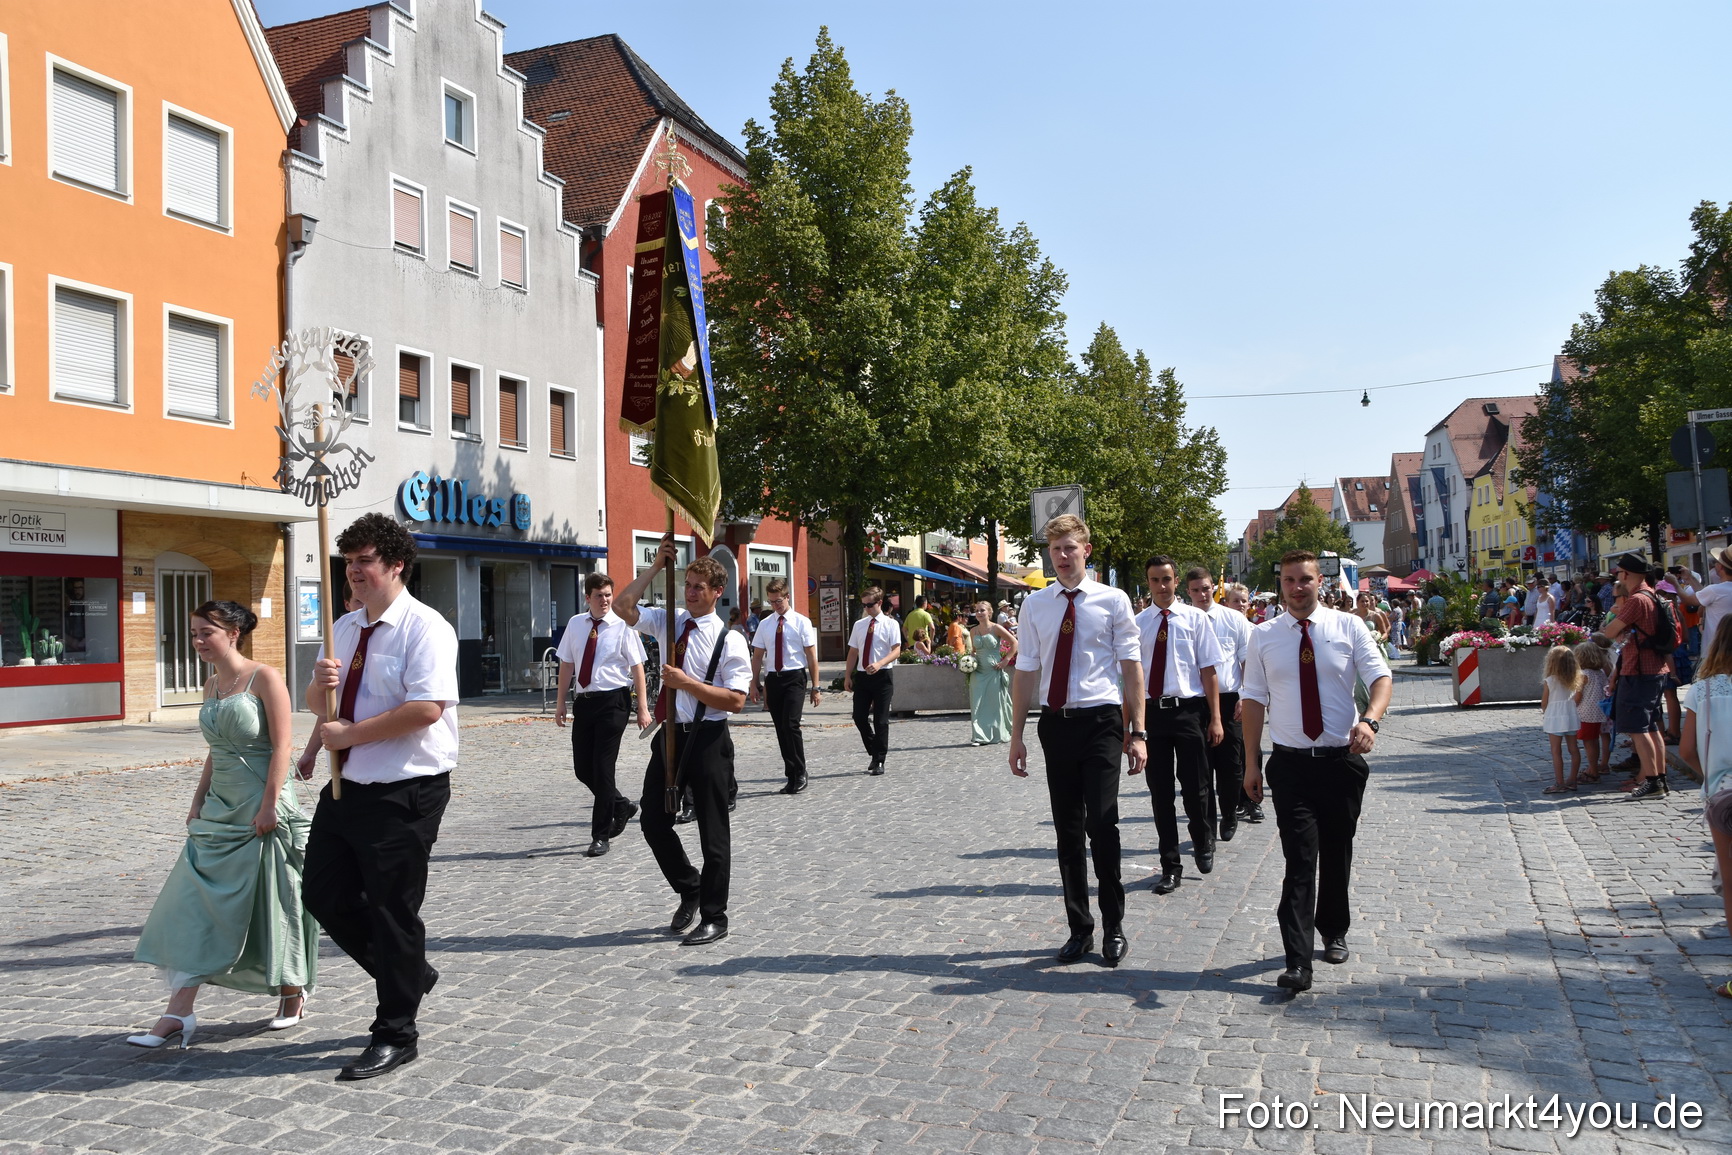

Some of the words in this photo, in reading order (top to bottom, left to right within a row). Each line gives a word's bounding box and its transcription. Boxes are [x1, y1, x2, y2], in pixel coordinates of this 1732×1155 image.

[250, 326, 377, 402] Burschenverein
[1696, 412, 1714, 420] Ulmer
[400, 470, 506, 528] Eilles
[11, 513, 42, 527] Optik
[11, 530, 65, 543] CENTRUM
[305, 554, 313, 563] 31
[754, 557, 780, 572] fielmann
[133, 566, 143, 576] 30
